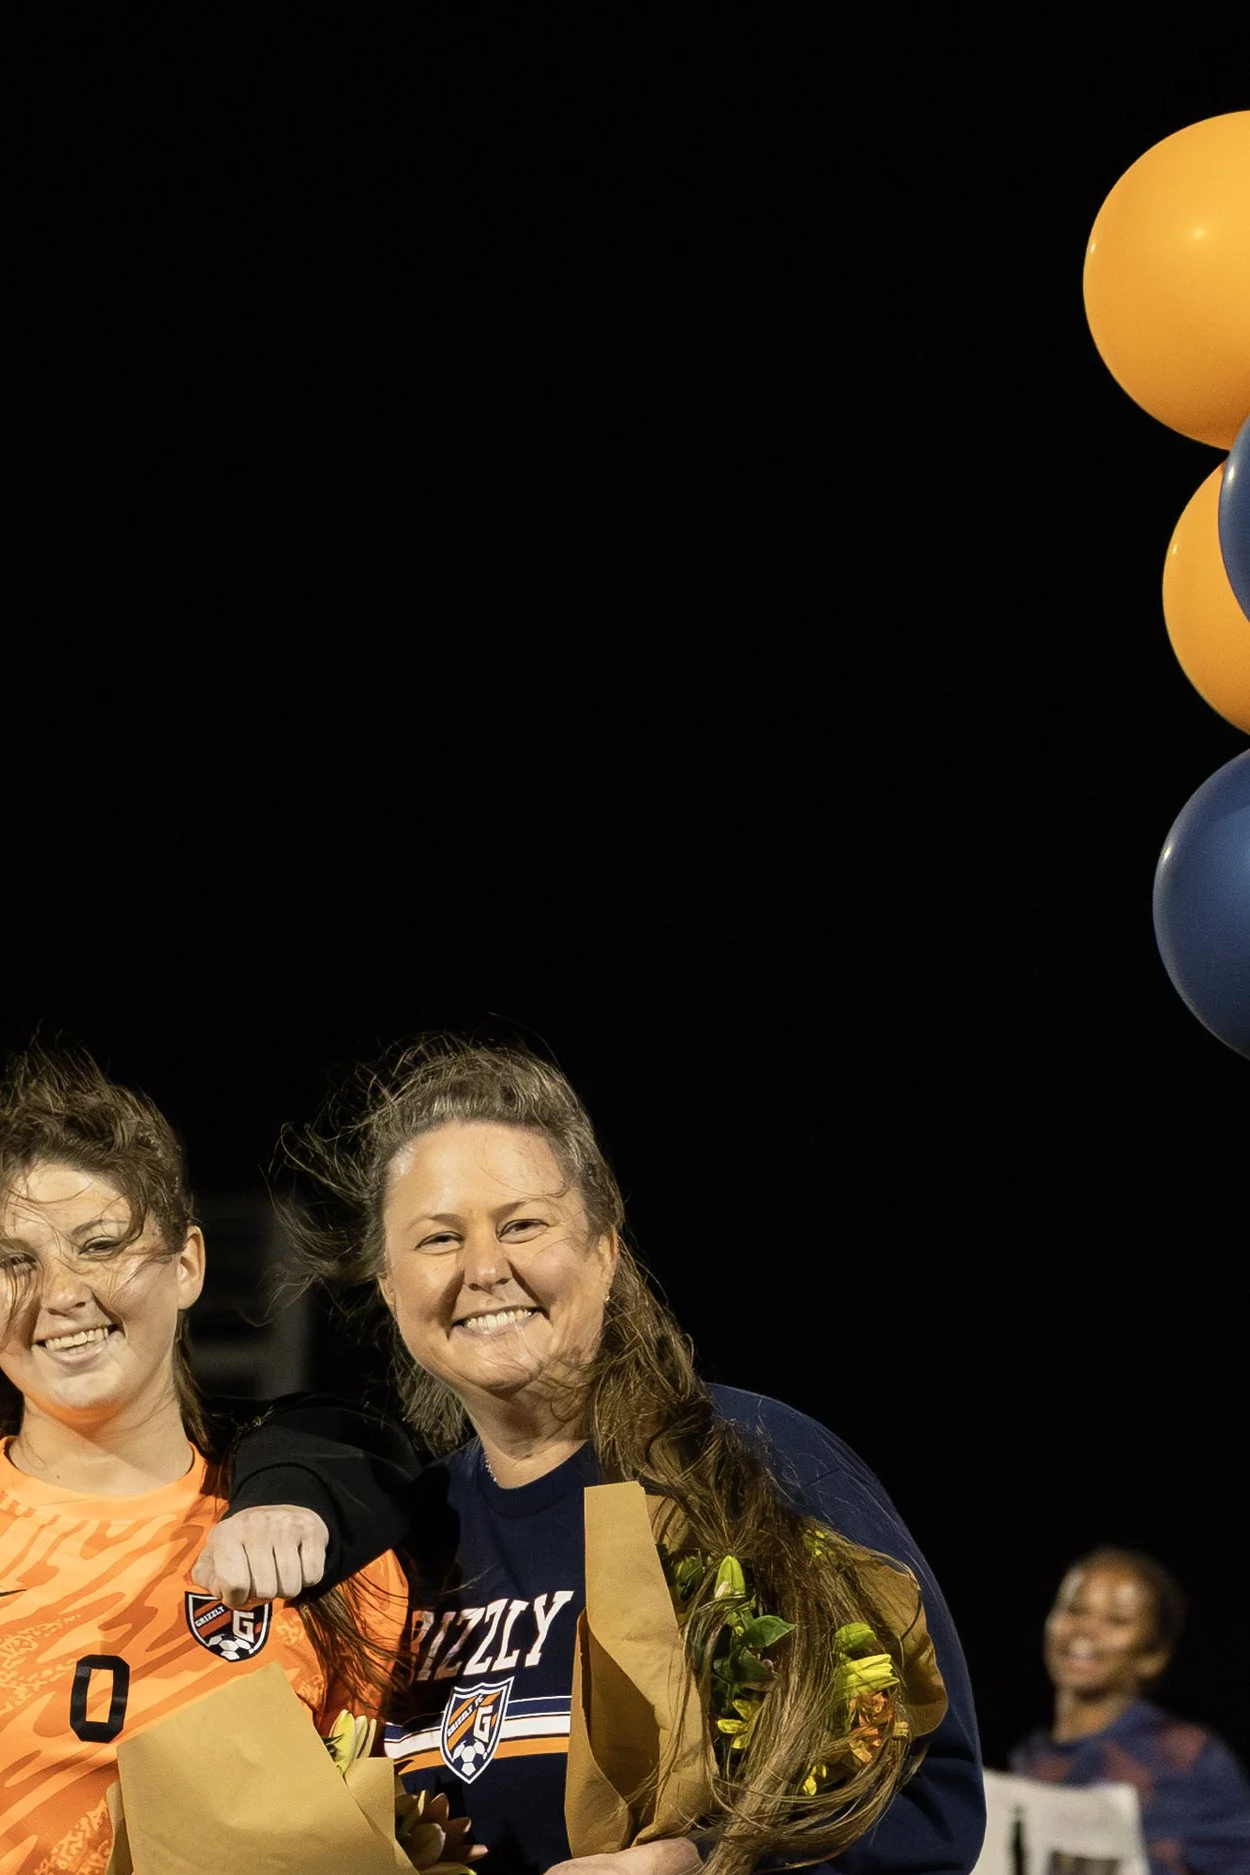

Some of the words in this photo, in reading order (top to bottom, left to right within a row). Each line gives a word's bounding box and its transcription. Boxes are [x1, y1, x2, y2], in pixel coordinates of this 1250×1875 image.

[194, 1605, 226, 1628] GRIZZLY
[232, 1609, 255, 1644] G
[472, 1704, 494, 1744] G
